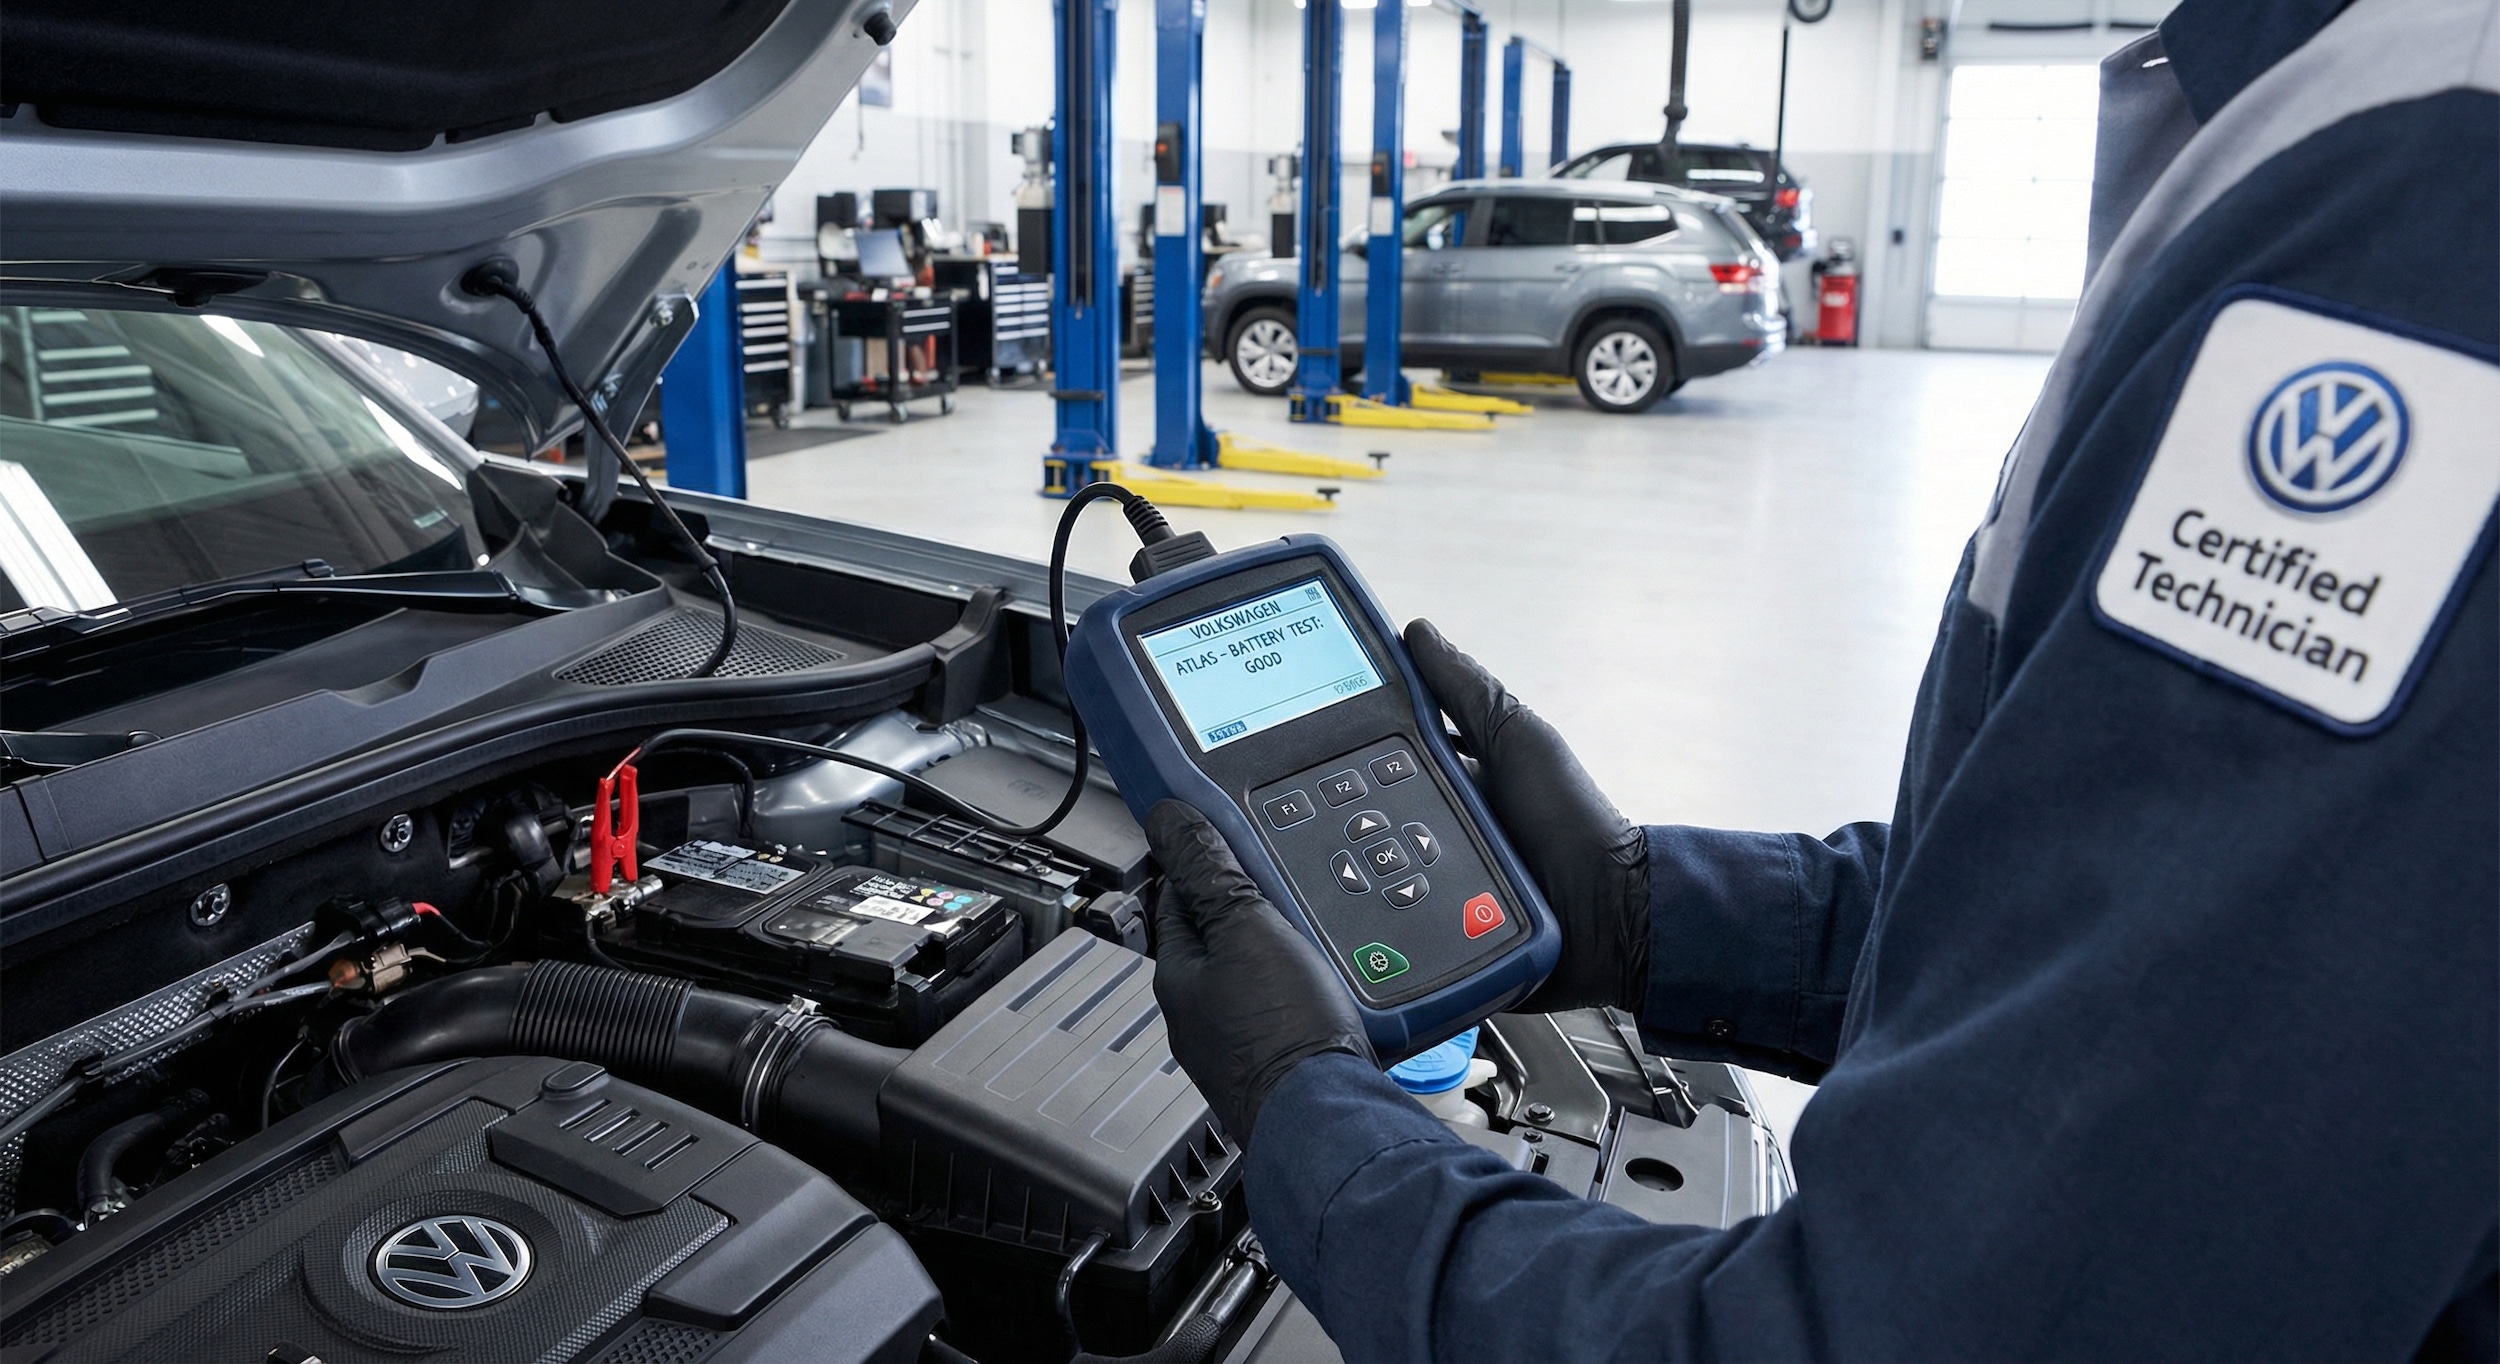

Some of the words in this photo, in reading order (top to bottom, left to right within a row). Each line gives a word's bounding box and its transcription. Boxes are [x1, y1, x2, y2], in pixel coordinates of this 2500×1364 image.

[2172, 509, 2381, 616] Certified
[1189, 599, 1282, 638] VOLKSWAGEN
[2134, 551, 2369, 682] Technician
[1176, 651, 1218, 676] ATLAS
[1228, 627, 1286, 657] BATTERY
[1287, 615, 1324, 638] TEST:
[1244, 651, 1283, 674] GOOD
[1386, 761, 1403, 774] F2
[1335, 780, 1353, 793] F2
[1281, 802, 1298, 816] F1
[1376, 847, 1398, 865] OK
